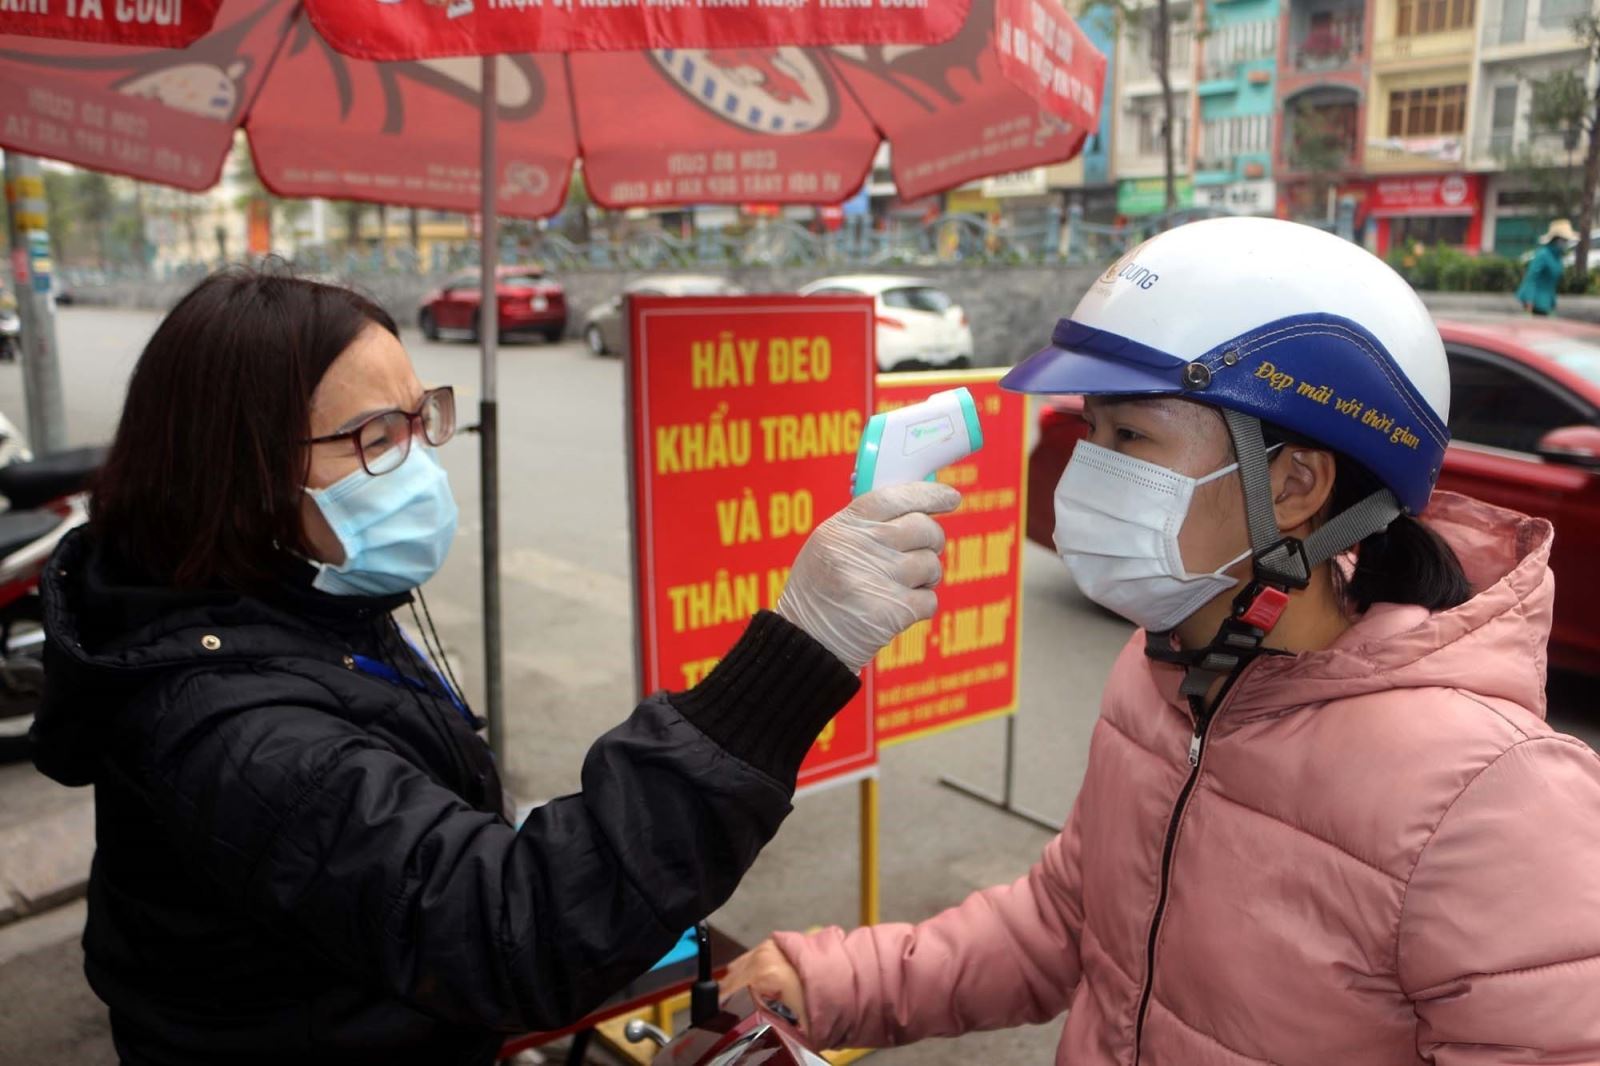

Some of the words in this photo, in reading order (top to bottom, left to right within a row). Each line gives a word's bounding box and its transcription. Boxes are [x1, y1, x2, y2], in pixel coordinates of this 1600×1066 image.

[691, 331, 759, 390] HÃY
[769, 336, 832, 385] ĐEO
[1254, 360, 1294, 391] Đẹp
[1296, 381, 1335, 405] mãi
[1335, 397, 1364, 419] với
[1361, 408, 1395, 434] thời
[1390, 426, 1420, 450] gian
[656, 401, 750, 475] KHẨU
[760, 409, 862, 464] TRANG
[716, 487, 762, 546] VÀ
[770, 489, 813, 538] ĐO
[667, 569, 759, 634] THÂN
